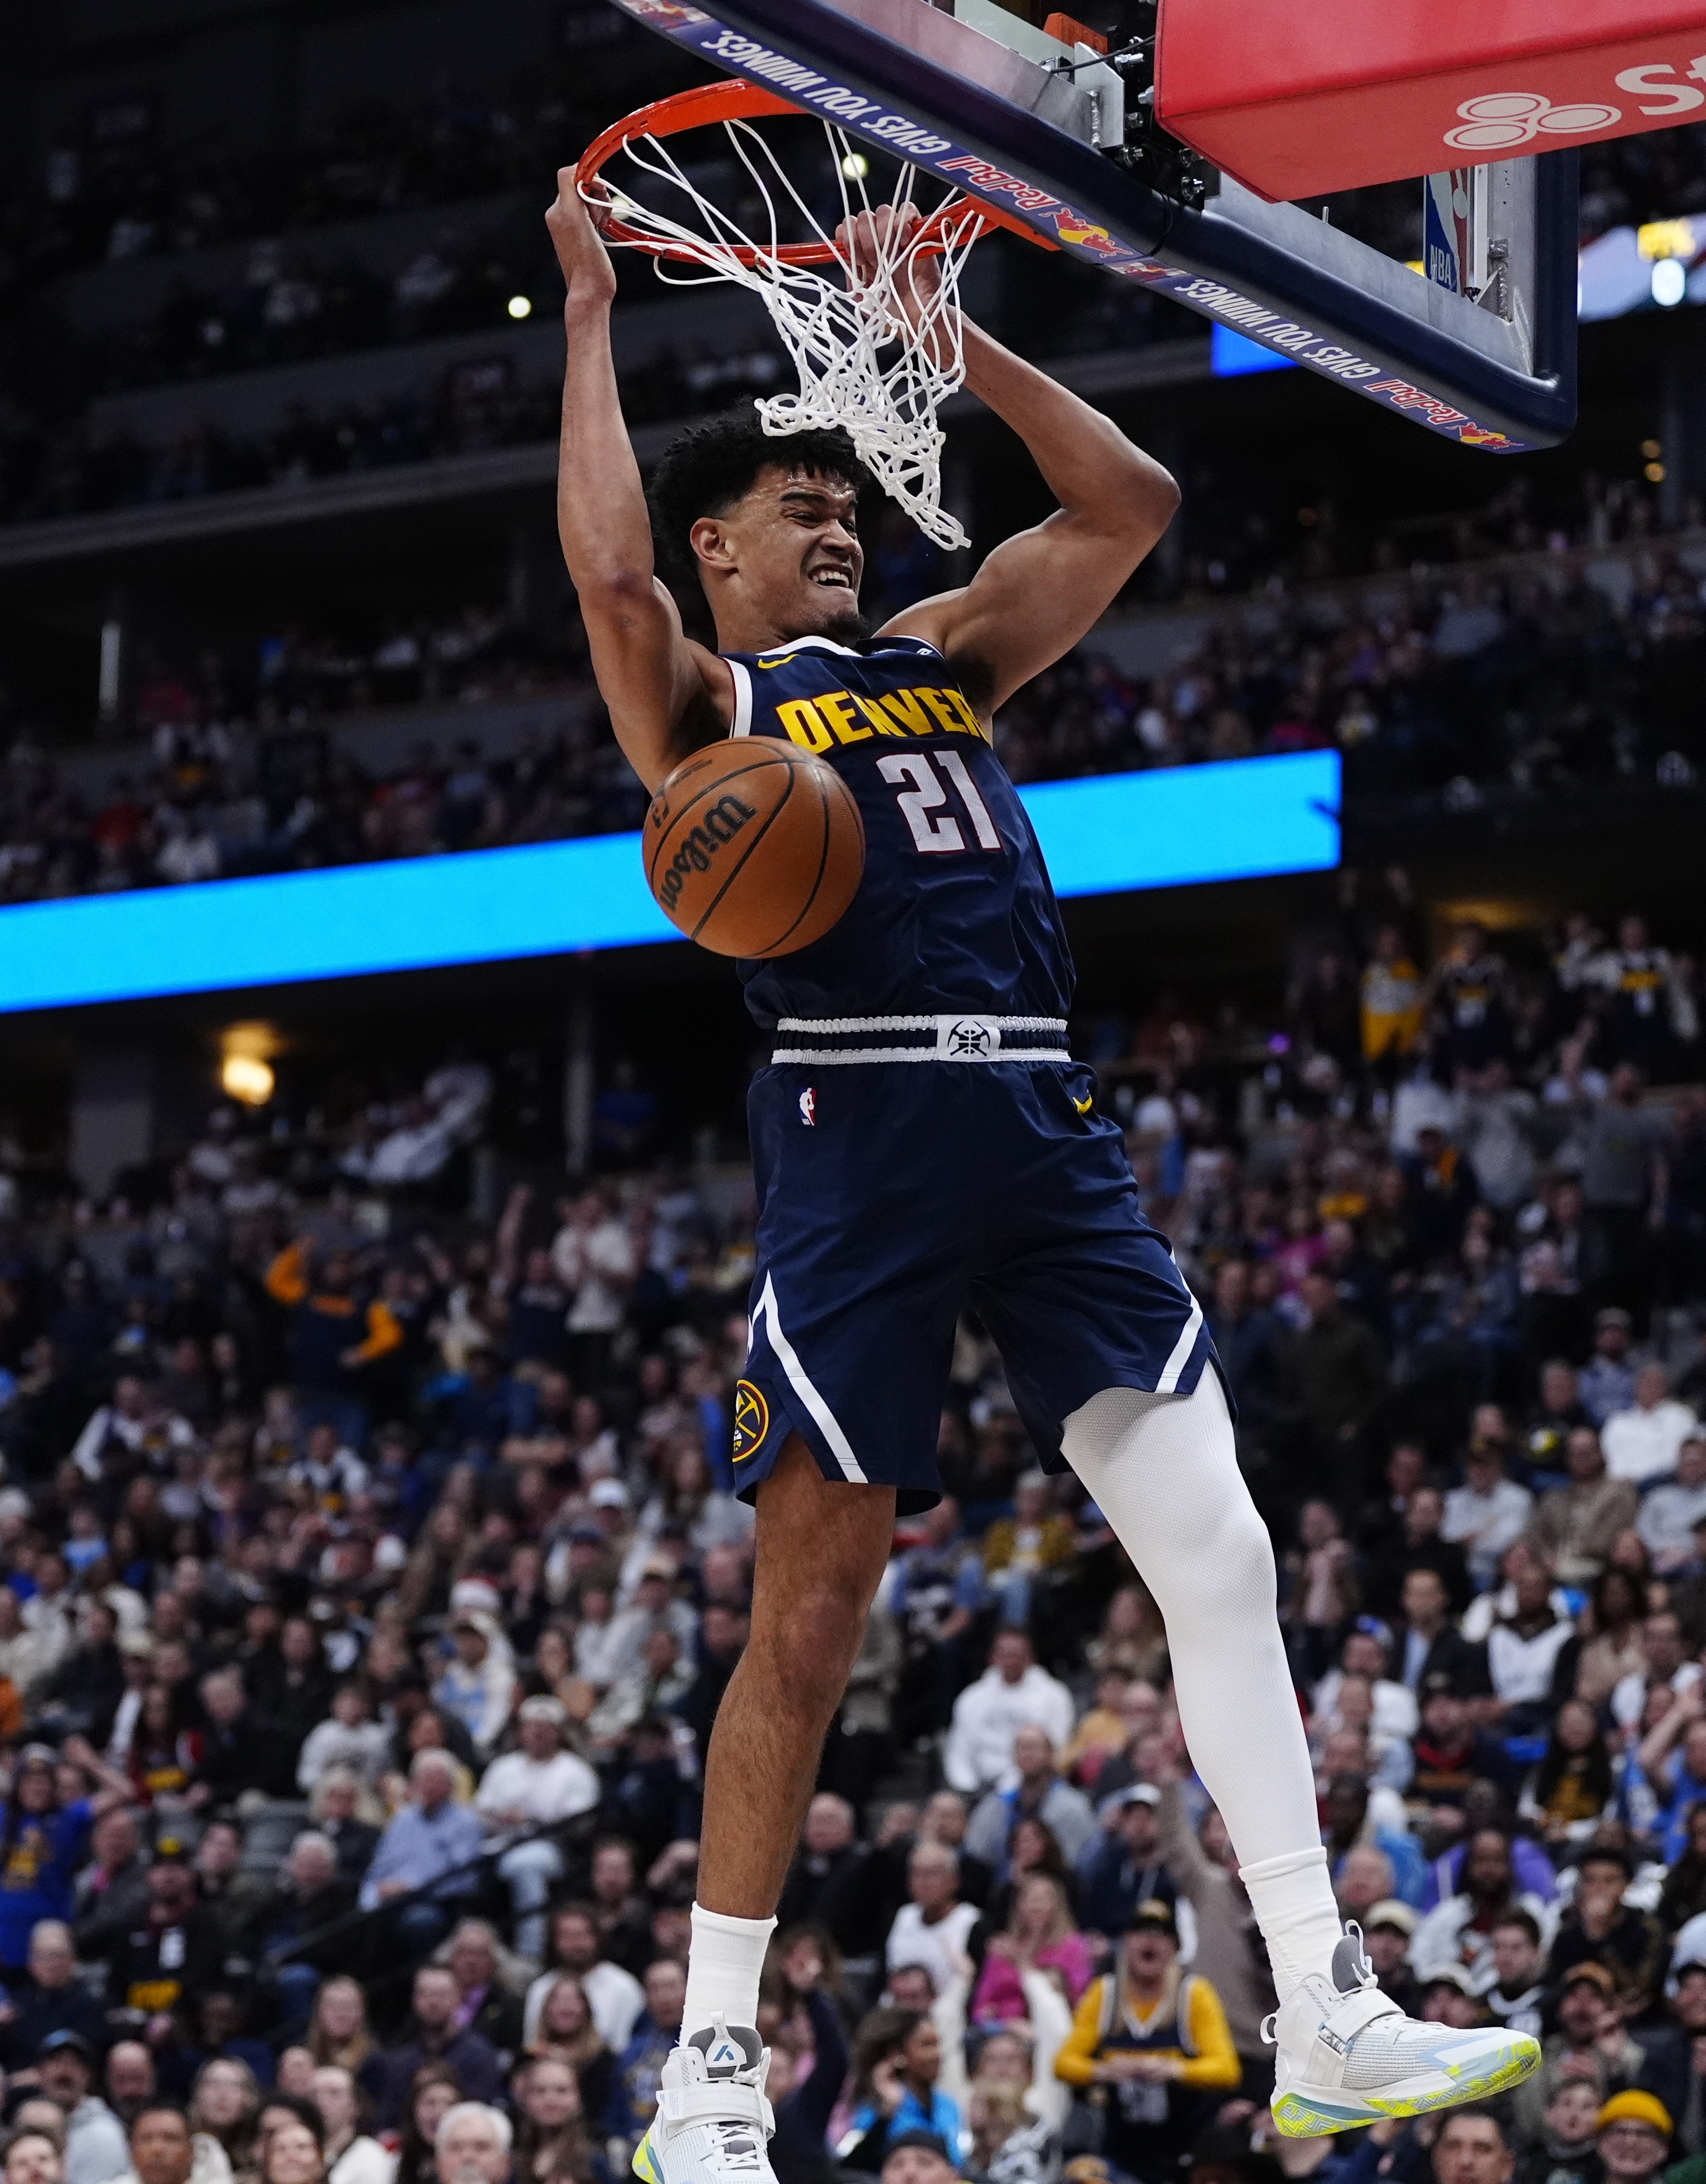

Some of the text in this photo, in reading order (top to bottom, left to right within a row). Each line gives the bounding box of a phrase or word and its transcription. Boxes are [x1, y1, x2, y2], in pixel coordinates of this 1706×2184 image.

[803, 87, 883, 120] YOU
[860, 116, 952, 155] GIVES
[1430, 244, 1452, 287] NBA
[1256, 323, 1325, 352] YOU
[1302, 347, 1381, 379] GIVES
[776, 687, 989, 755] DENVER
[875, 750, 1002, 853] 21
[659, 794, 758, 912] Wilson
